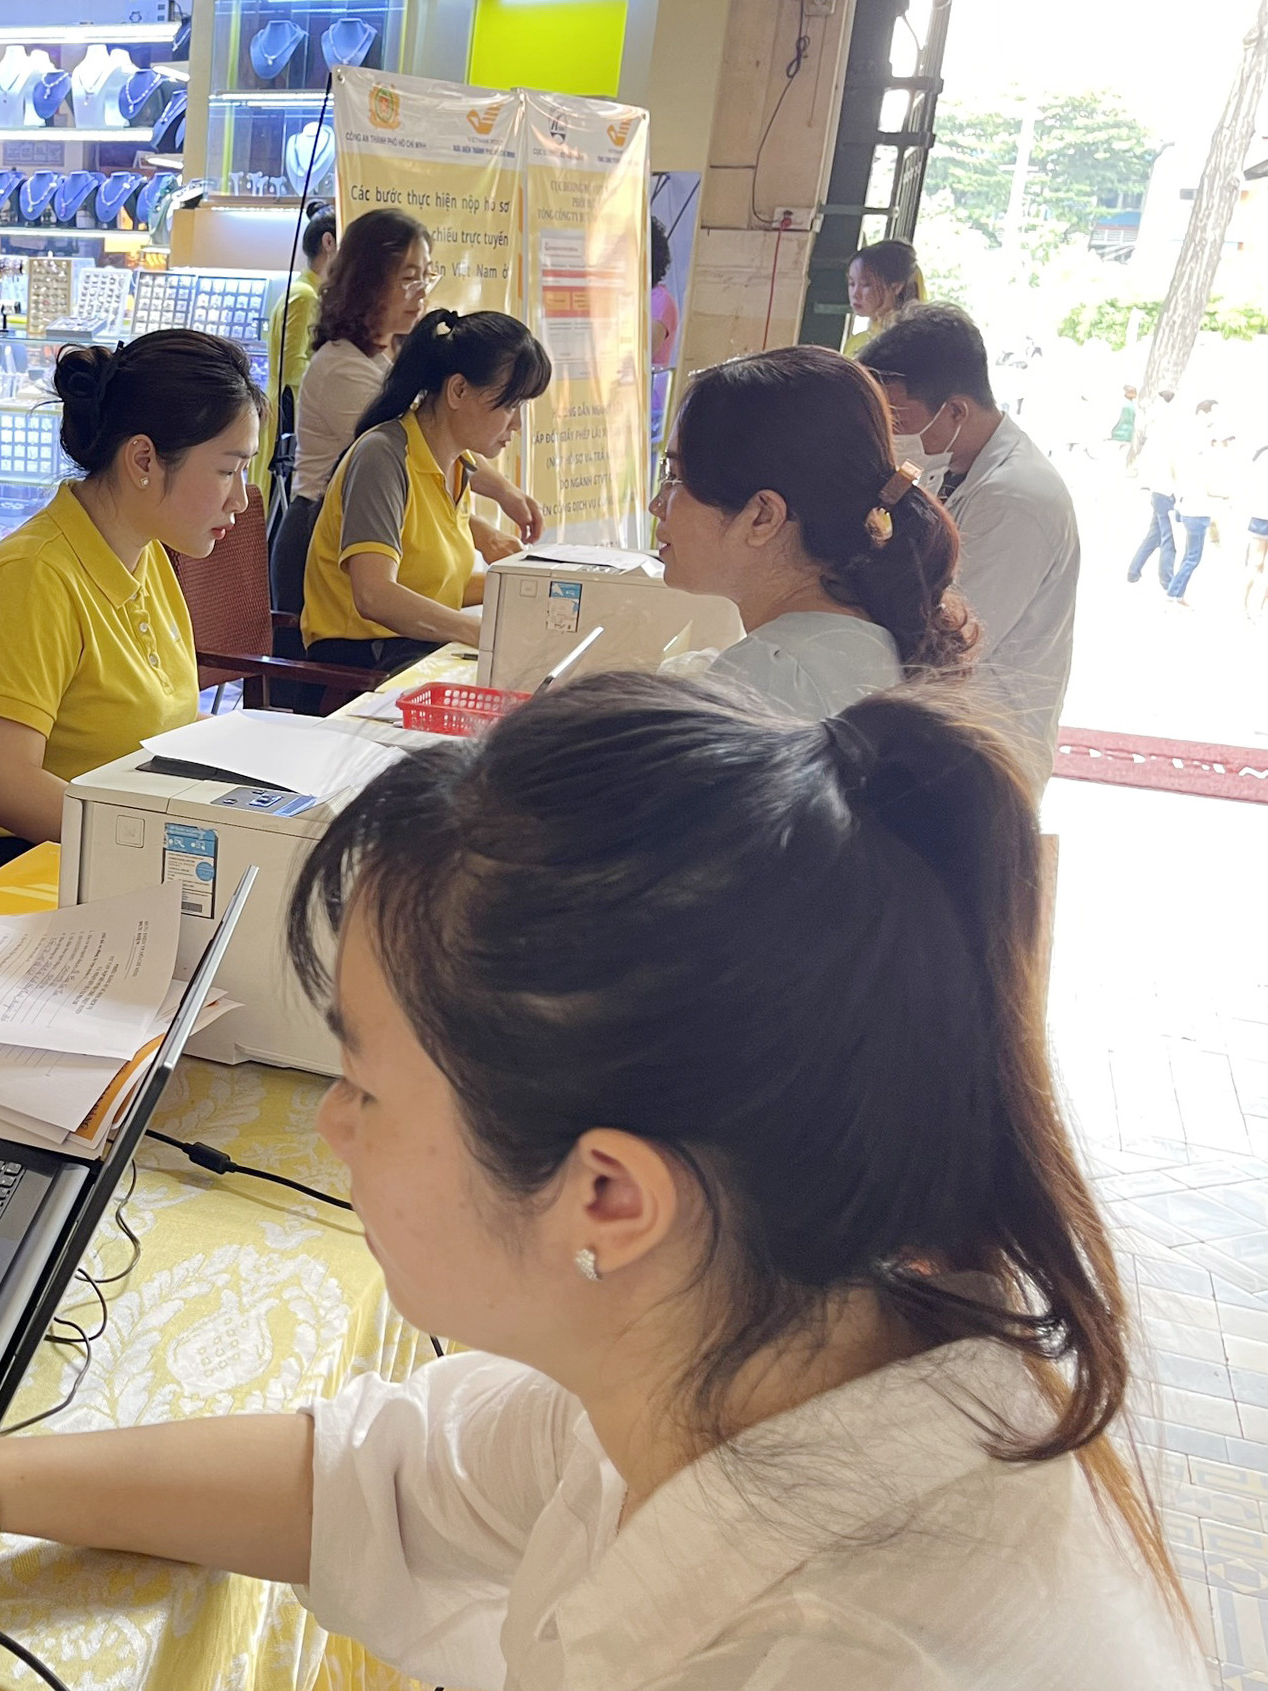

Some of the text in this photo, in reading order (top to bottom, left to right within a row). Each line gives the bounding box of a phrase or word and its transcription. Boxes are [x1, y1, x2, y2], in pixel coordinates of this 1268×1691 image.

[350, 184, 370, 202] Các
[375, 186, 402, 204] bước
[407, 189, 431, 210] thực
[435, 191, 457, 212] hiện
[461, 194, 480, 214] nộp
[499, 200, 510, 213] sơ
[432, 226, 509, 250] chiếu trực tuyến
[476, 264, 498, 279] Nam
